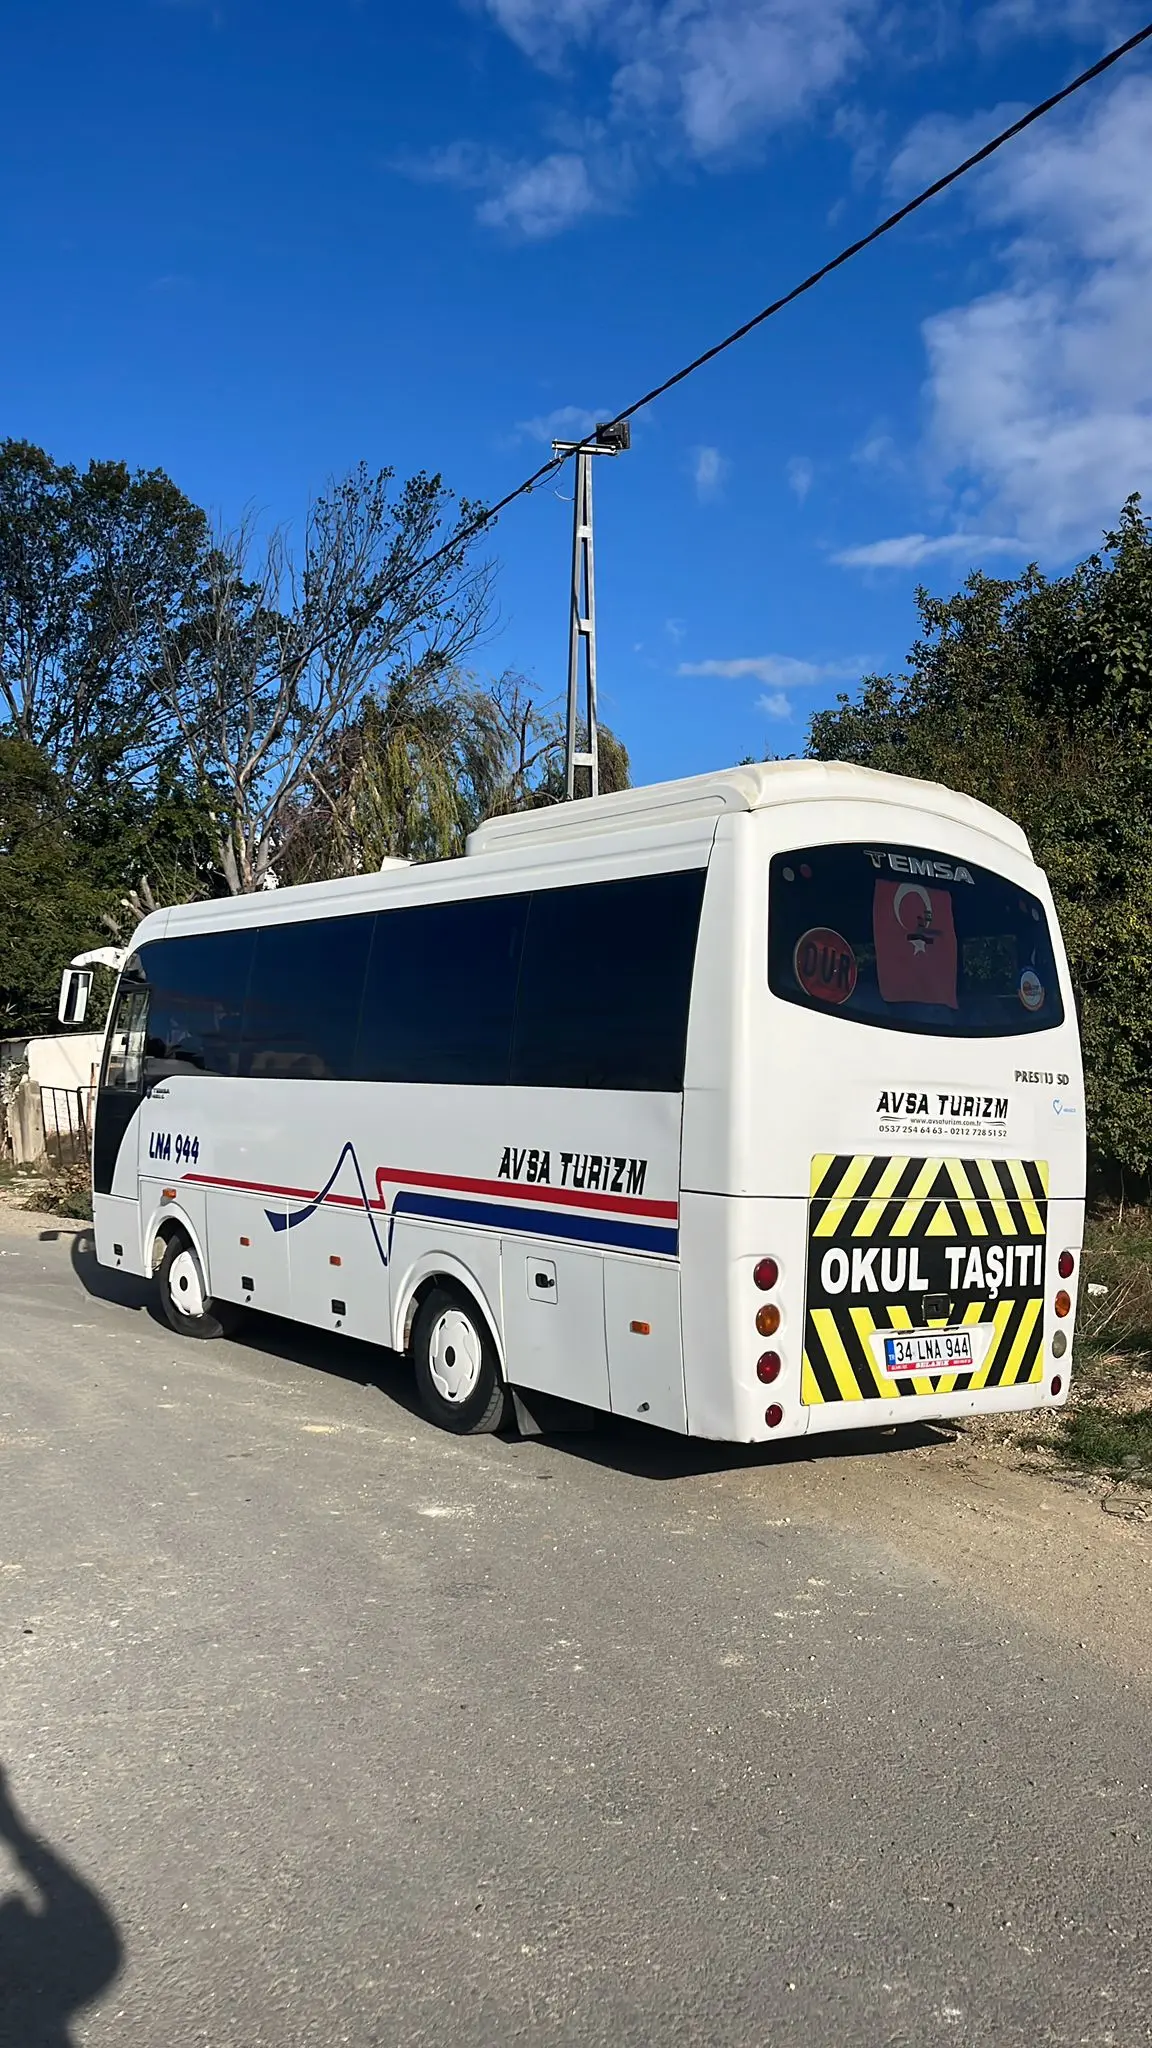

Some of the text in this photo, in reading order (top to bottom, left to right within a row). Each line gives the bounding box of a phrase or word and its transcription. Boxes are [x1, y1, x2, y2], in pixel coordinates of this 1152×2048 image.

[863, 850, 975, 885] TEMSA
[1057, 1073, 1069, 1085] SD
[876, 1091, 929, 1115] AVSA
[879, 1125, 901, 1133] 0537
[902, 1125, 918, 1134] 254
[920, 1126, 930, 1134] 64
[932, 1127, 943, 1135] 63
[950, 1128, 970, 1136] 0212
[972, 1128, 987, 1137] 728
[988, 1129, 997, 1137] 51
[998, 1130, 1007, 1138] 52
[149, 1131, 200, 1164] LNA 944
[498, 1146, 551, 1185] AVSA
[820, 1244, 1042, 1300] OKUL TAŞITI
[896, 1342, 913, 1362] 34
[917, 1339, 942, 1360] LNA
[946, 1337, 969, 1358] 944
